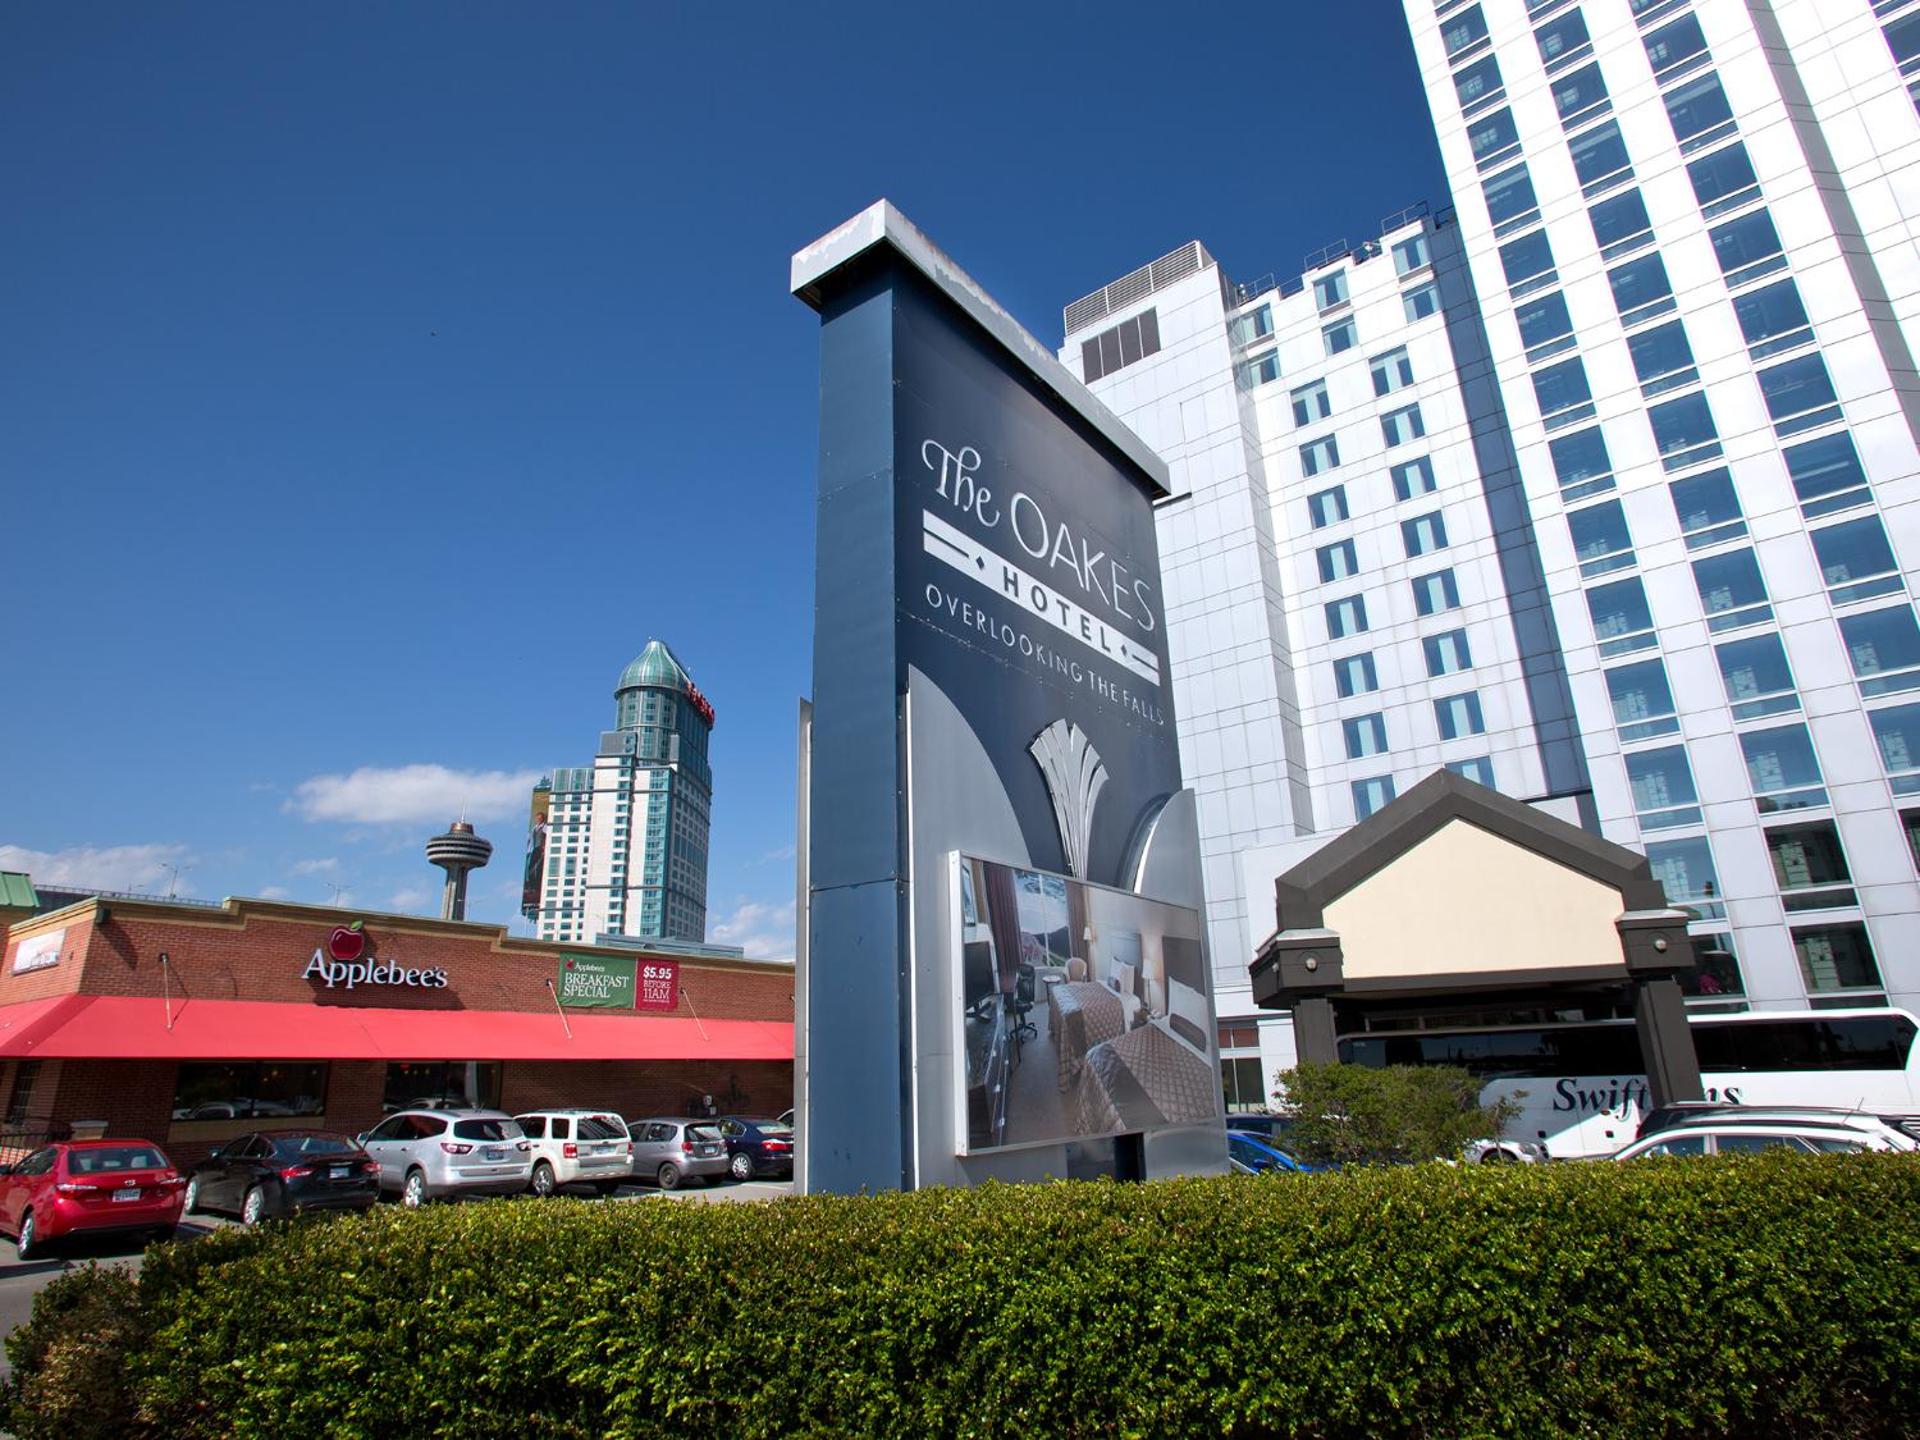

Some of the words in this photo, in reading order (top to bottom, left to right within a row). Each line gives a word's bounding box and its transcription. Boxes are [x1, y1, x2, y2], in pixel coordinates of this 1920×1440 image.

[921, 438, 1001, 528] The
[1010, 491, 1155, 632] OAKES
[1002, 566, 1112, 653] HOTEL
[925, 582, 1083, 683] OVERLOOKING
[1087, 670, 1119, 703] THE
[1122, 689, 1165, 727] FALLS
[301, 948, 448, 989] Applebee's
[565, 972, 630, 989] BREAKFAST
[643, 964, 673, 980] $5.95
[563, 984, 611, 999] SPECIAL
[643, 979, 672, 989] BEFORE
